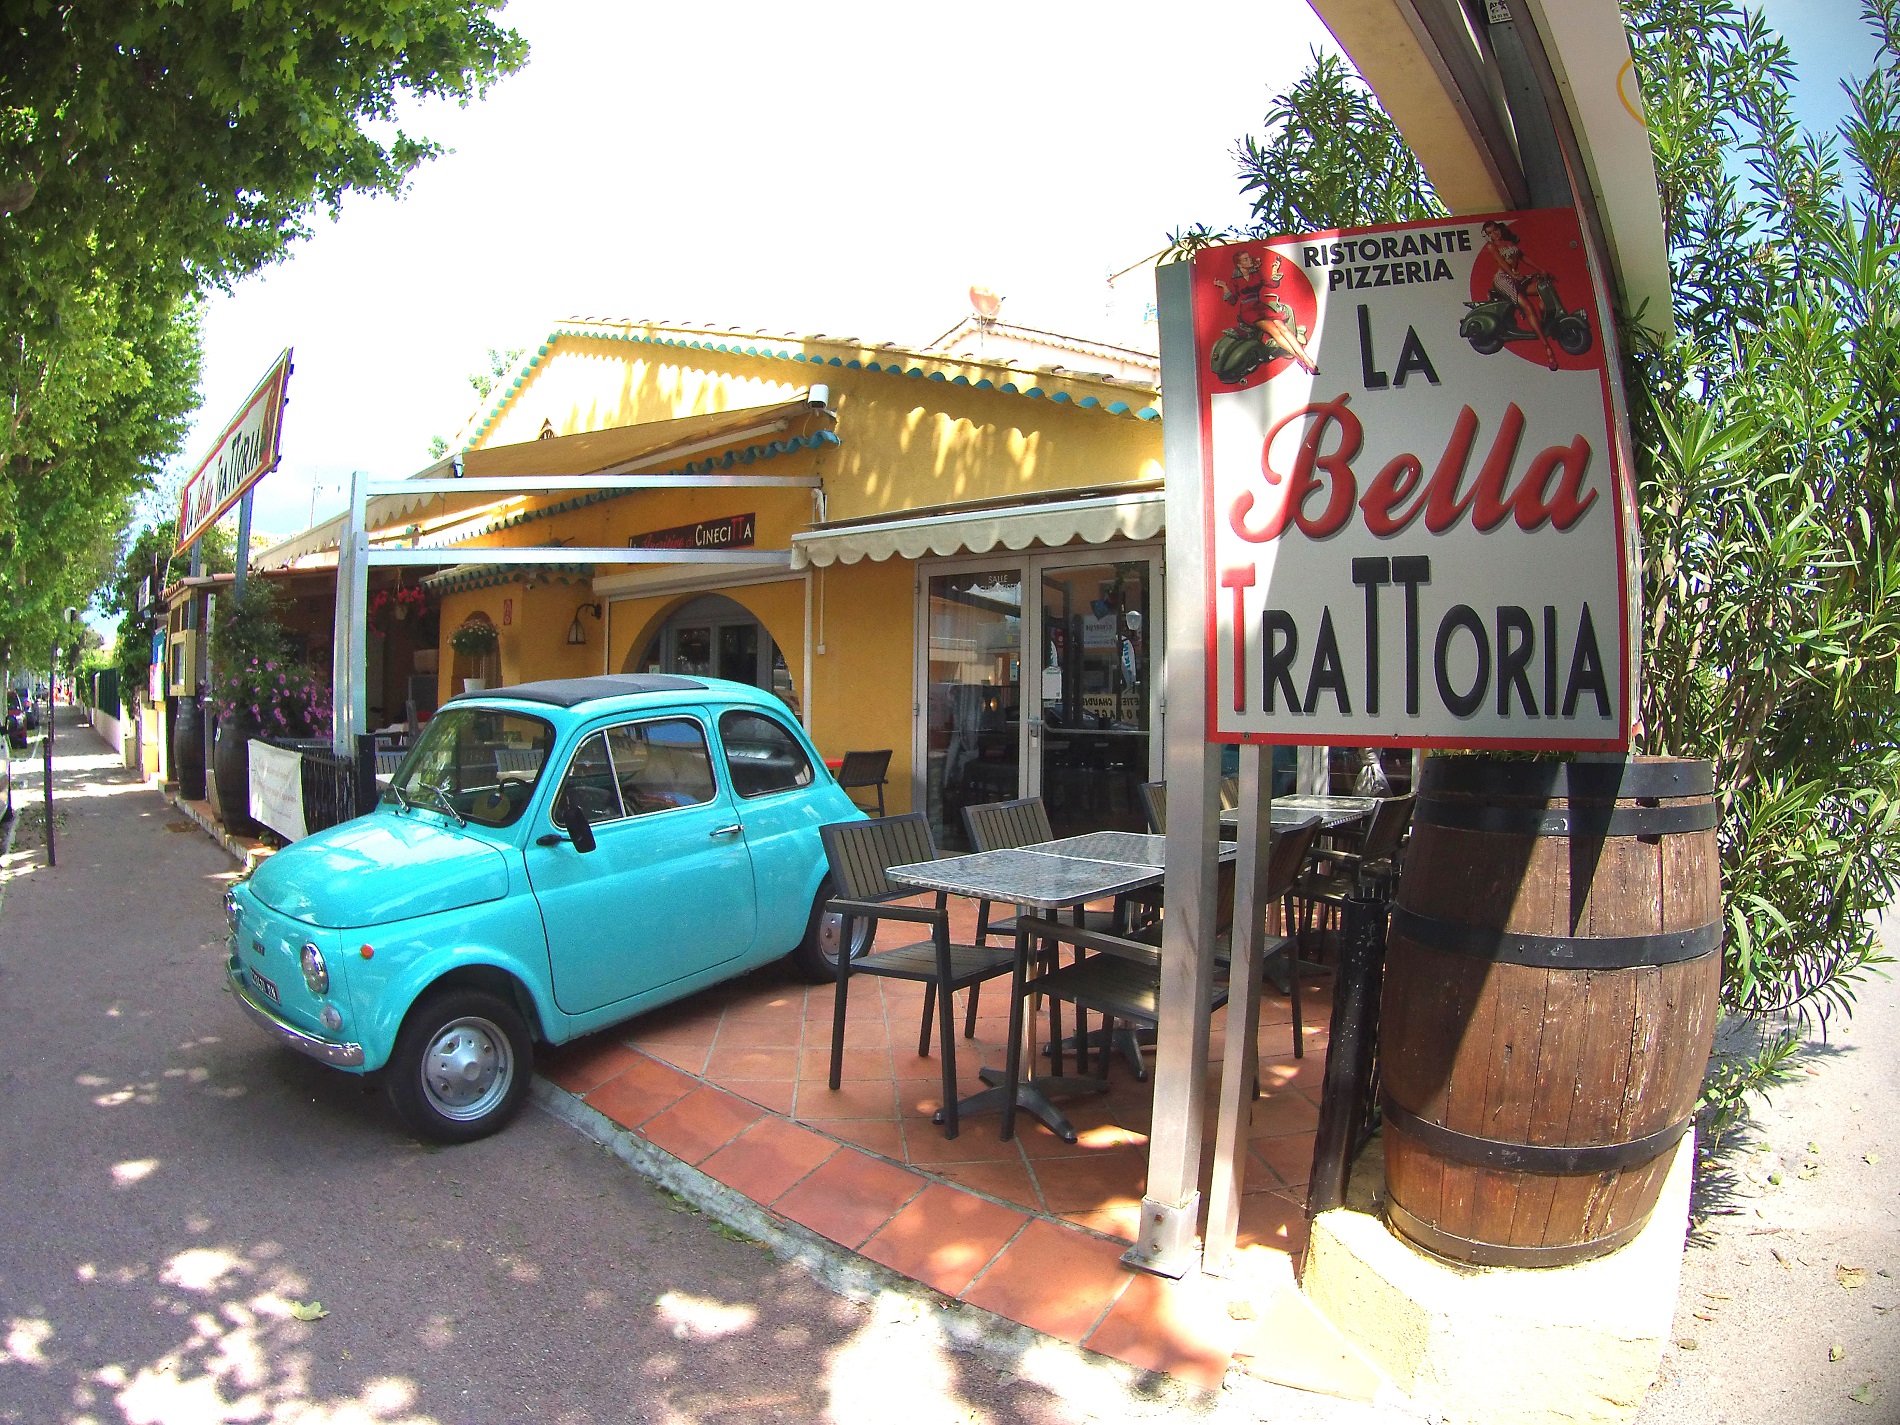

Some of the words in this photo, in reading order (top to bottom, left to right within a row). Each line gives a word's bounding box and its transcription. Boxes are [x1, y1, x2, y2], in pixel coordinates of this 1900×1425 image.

[1303, 230, 1472, 268] RISTORANTE
[1329, 259, 1454, 292] PIZZERIA
[1356, 304, 1441, 390] LA
[215, 426, 260, 508] TRATTORIA
[1228, 392, 1599, 544] Bella
[988, 574, 1008, 584] SALLE
[1220, 555, 1613, 717] TRATTORIA
